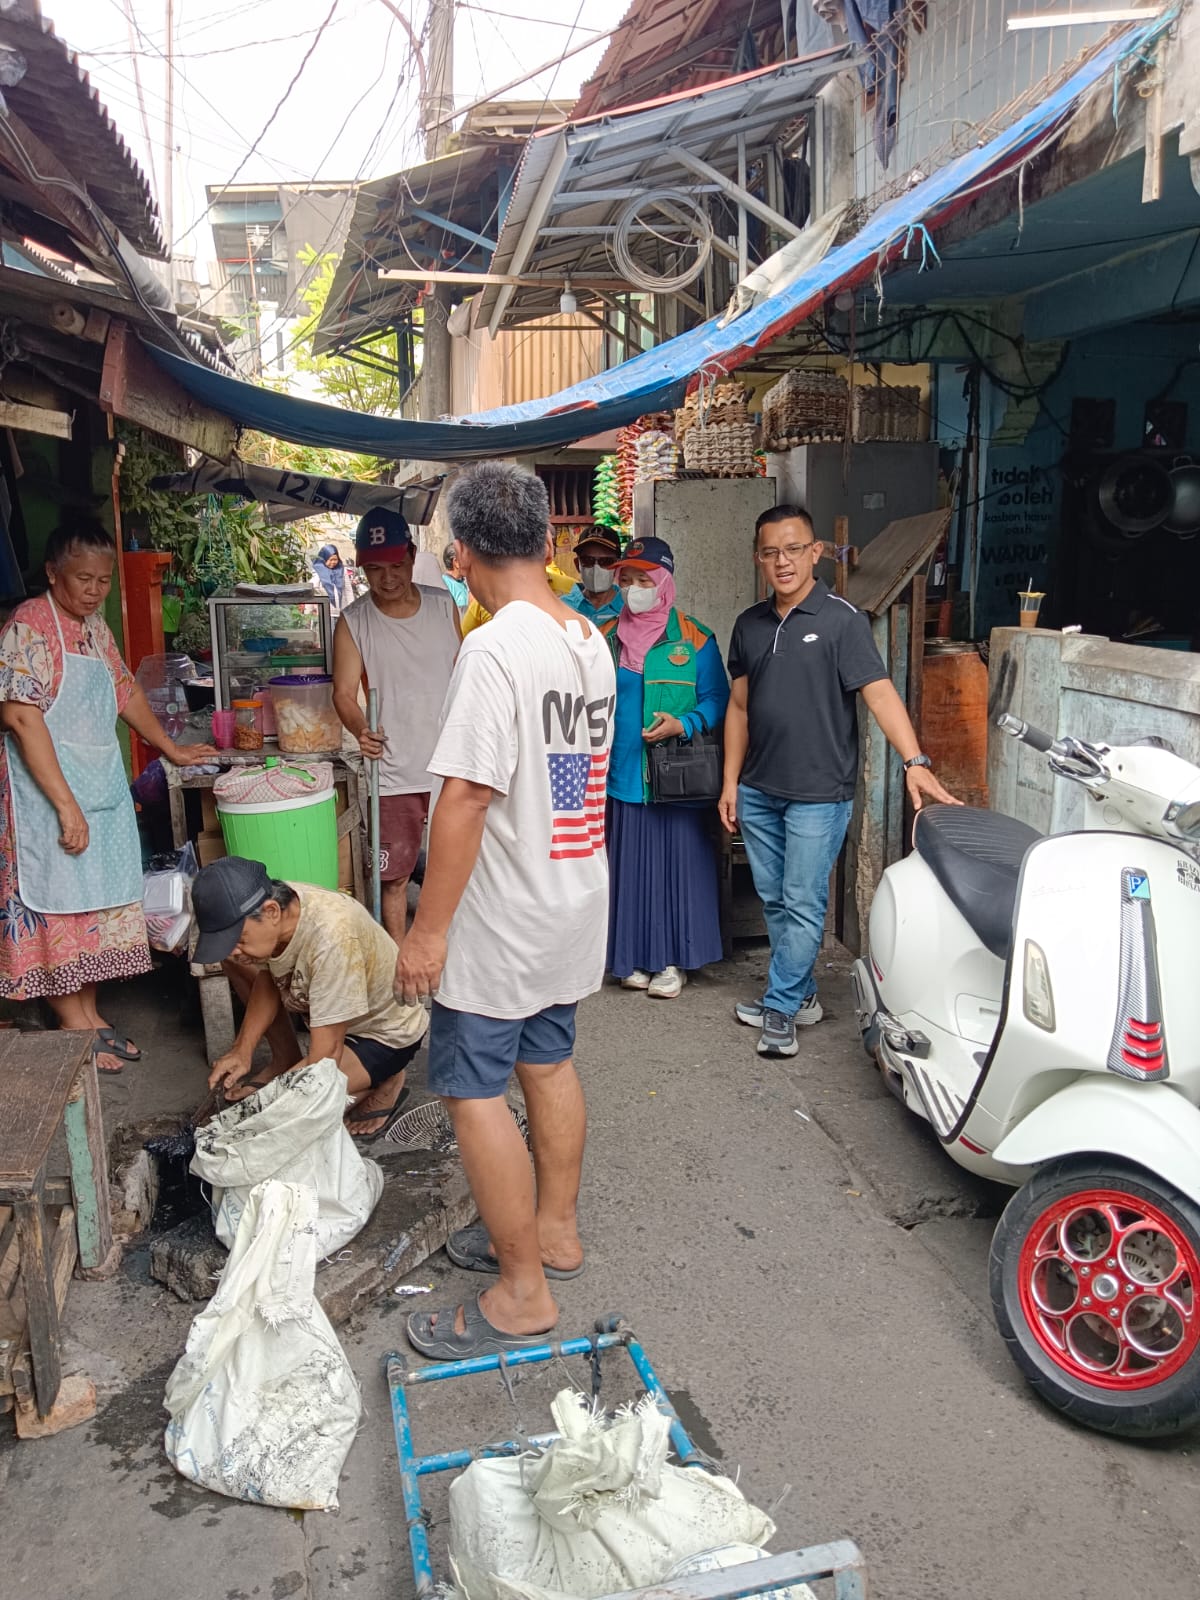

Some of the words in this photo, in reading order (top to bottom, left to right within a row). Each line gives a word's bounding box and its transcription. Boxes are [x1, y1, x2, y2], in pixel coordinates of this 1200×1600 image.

[991, 464, 1040, 484] tidak
[276, 472, 310, 502] 12
[368, 526, 386, 546] B
[1131, 877, 1142, 890] P
